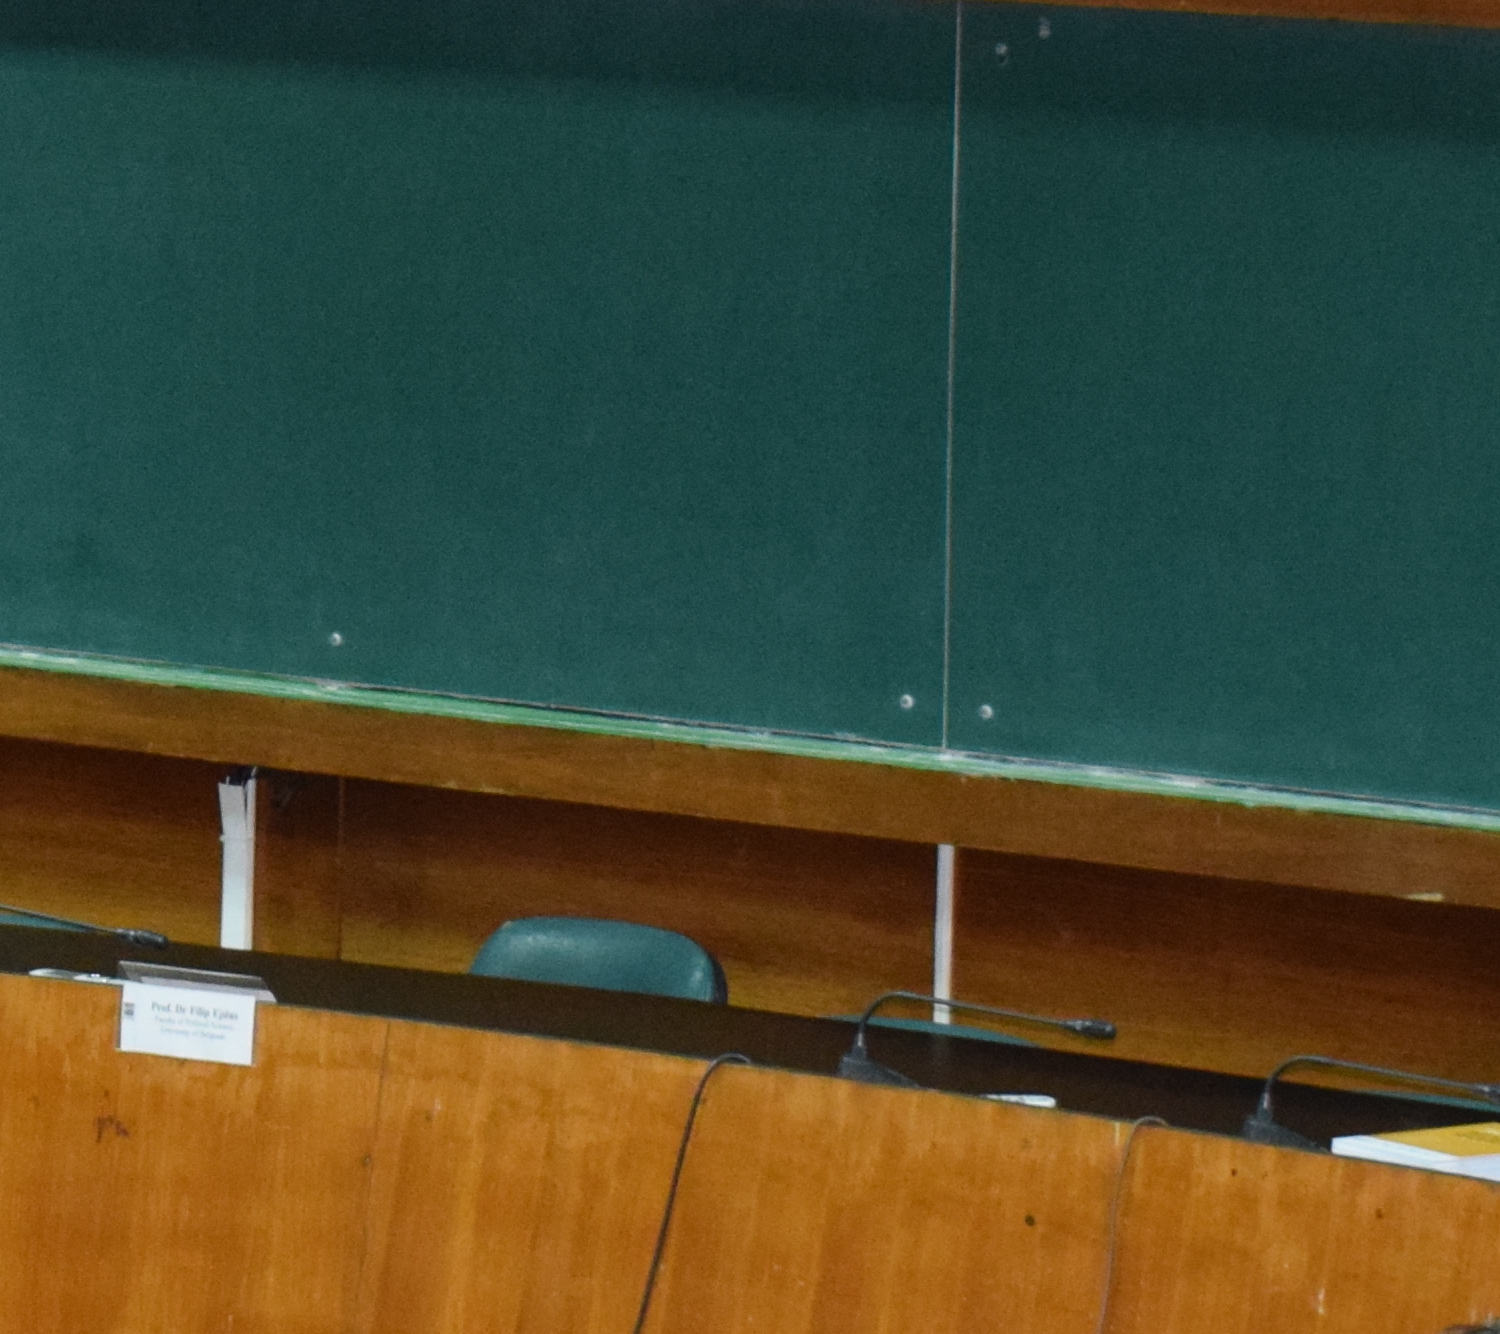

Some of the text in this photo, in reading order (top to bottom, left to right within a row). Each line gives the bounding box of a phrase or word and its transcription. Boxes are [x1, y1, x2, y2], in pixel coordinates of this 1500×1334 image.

[151, 1001, 171, 1013] Prof.
[175, 1004, 186, 1015] Dr
[190, 1005, 210, 1019] Filip
